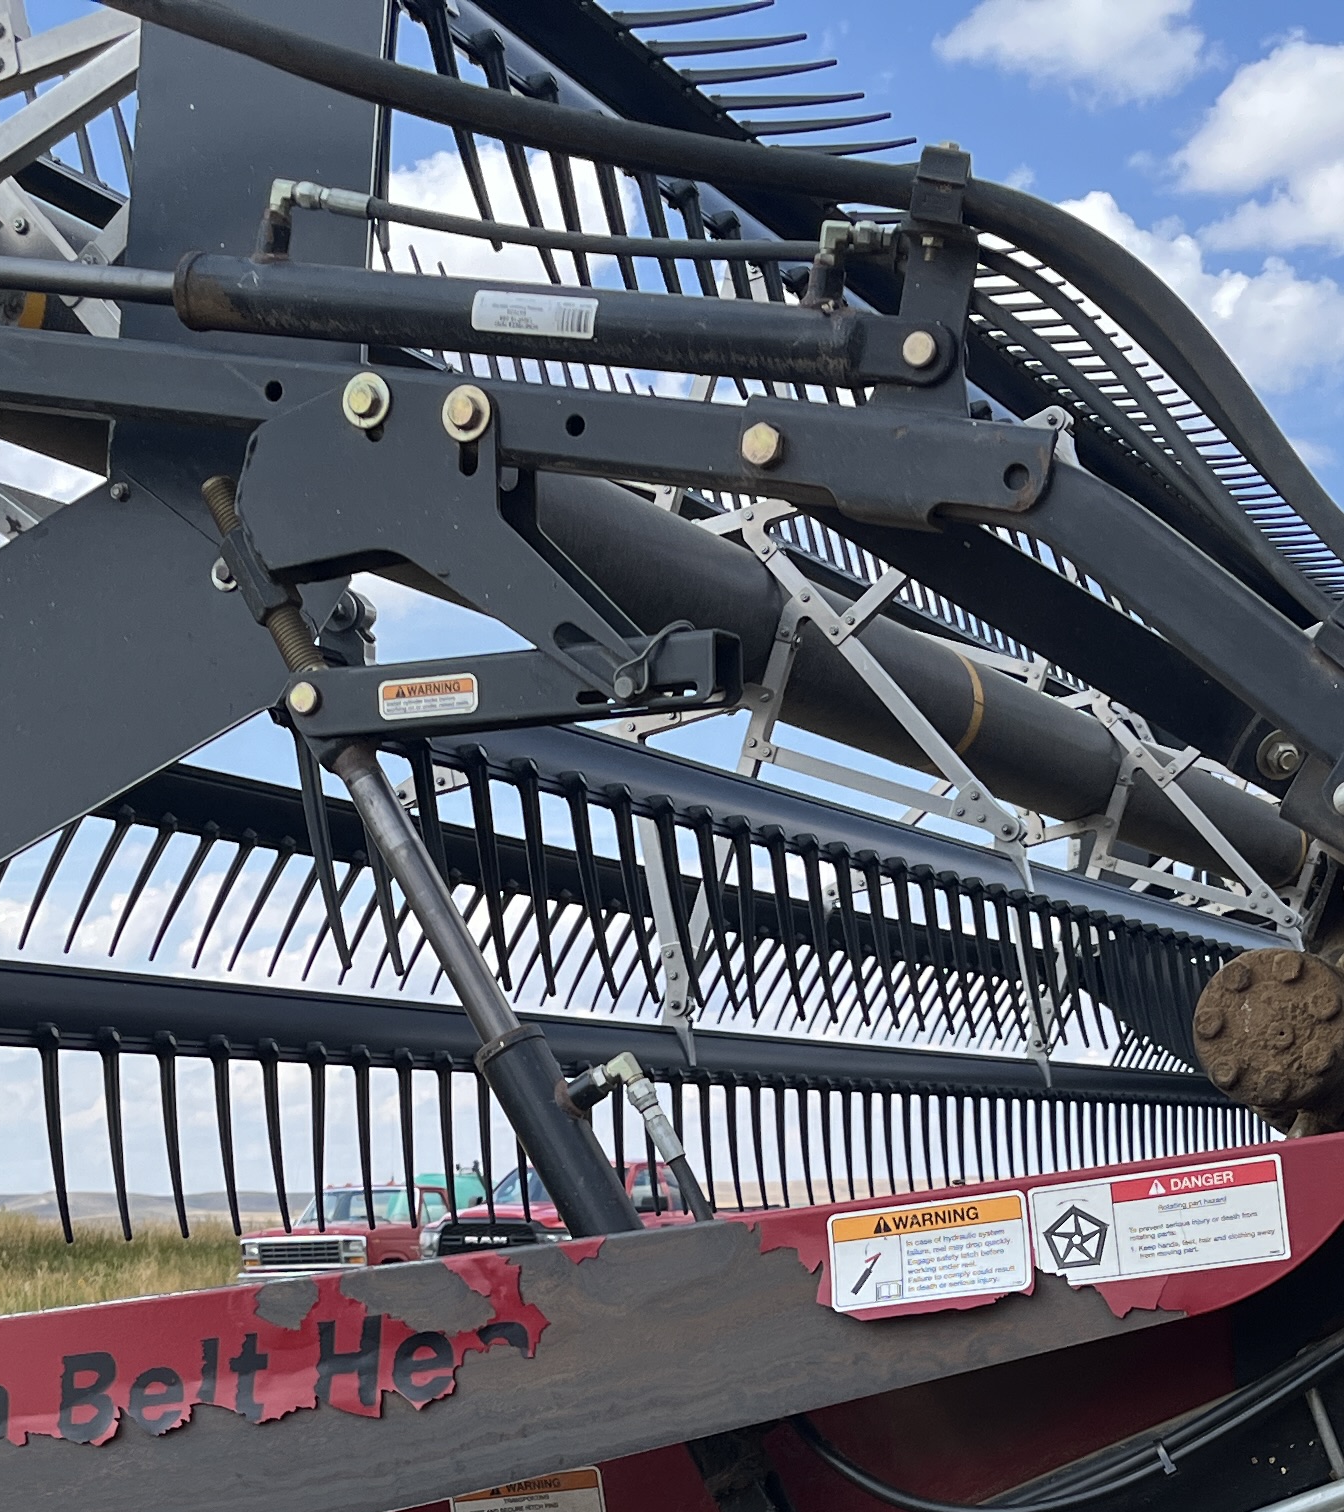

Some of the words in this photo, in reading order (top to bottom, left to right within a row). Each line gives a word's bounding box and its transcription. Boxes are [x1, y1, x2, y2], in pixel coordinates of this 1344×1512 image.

[407, 681, 461, 696] WARNING
[1170, 1170, 1234, 1192] DANGER
[892, 1205, 979, 1231] WARNING
[464, 1236, 508, 1244] RAM
[60, 1332, 267, 1444] Belt
[506, 1478, 560, 1493] WARNING
